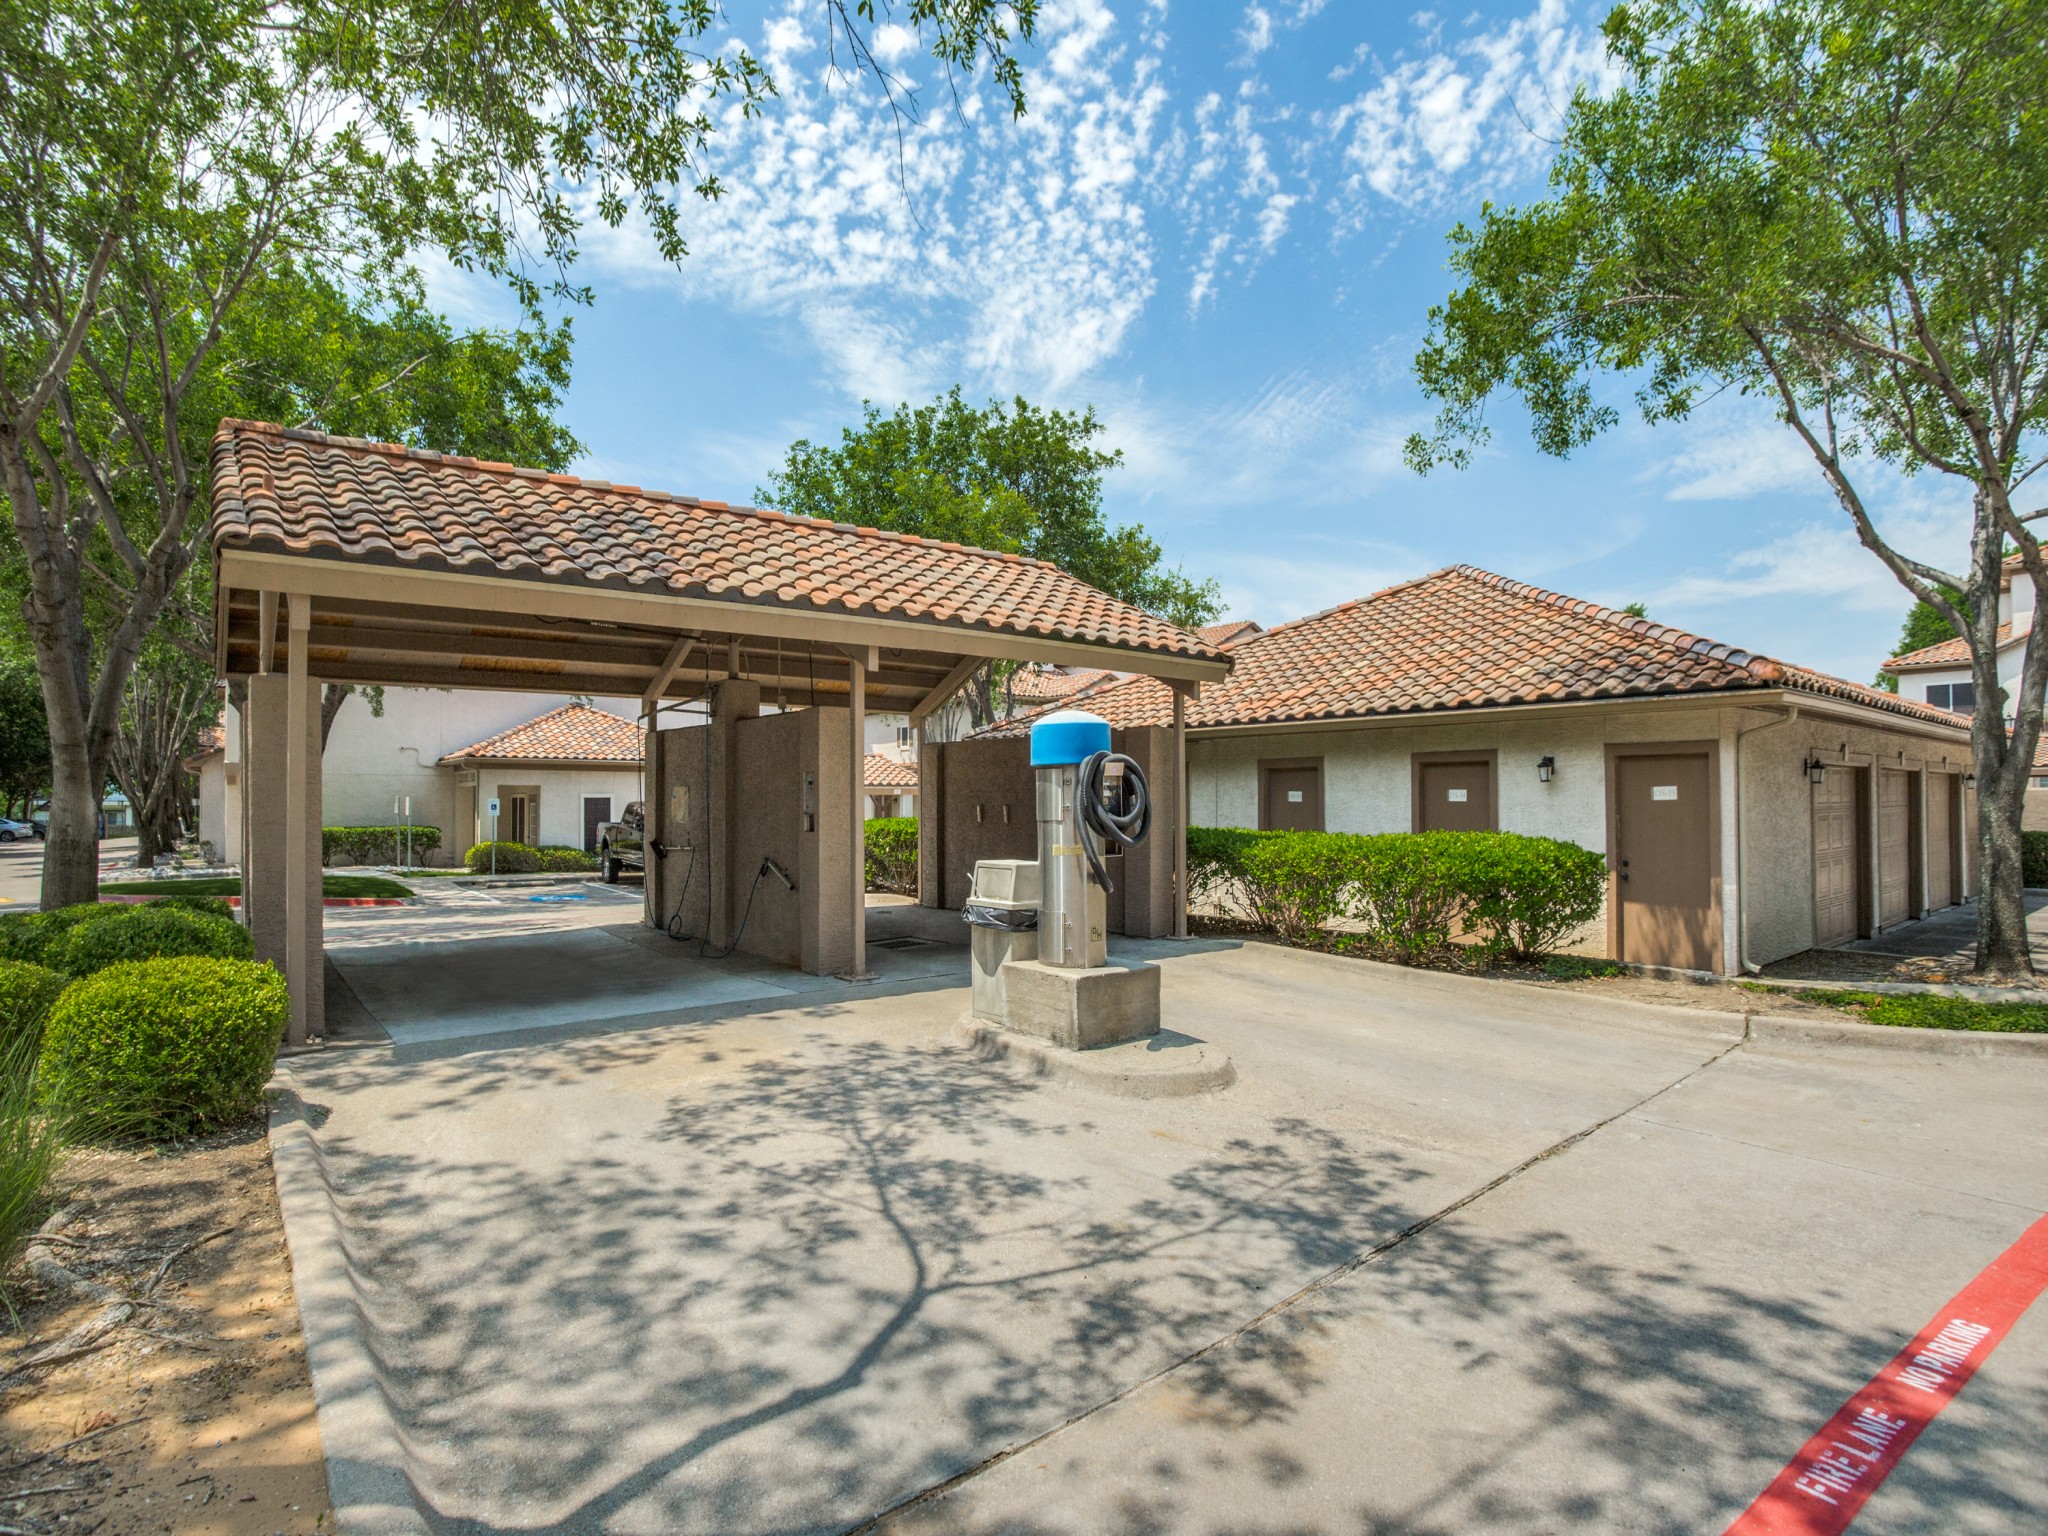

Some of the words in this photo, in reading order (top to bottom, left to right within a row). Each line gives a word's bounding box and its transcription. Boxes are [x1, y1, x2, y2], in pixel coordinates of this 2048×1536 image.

[1913, 1318, 1991, 1375] PARKING
[1895, 1366, 1945, 1393] NO
[1830, 1406, 1906, 1462] LANE
[1794, 1450, 1869, 1505] FIRE
